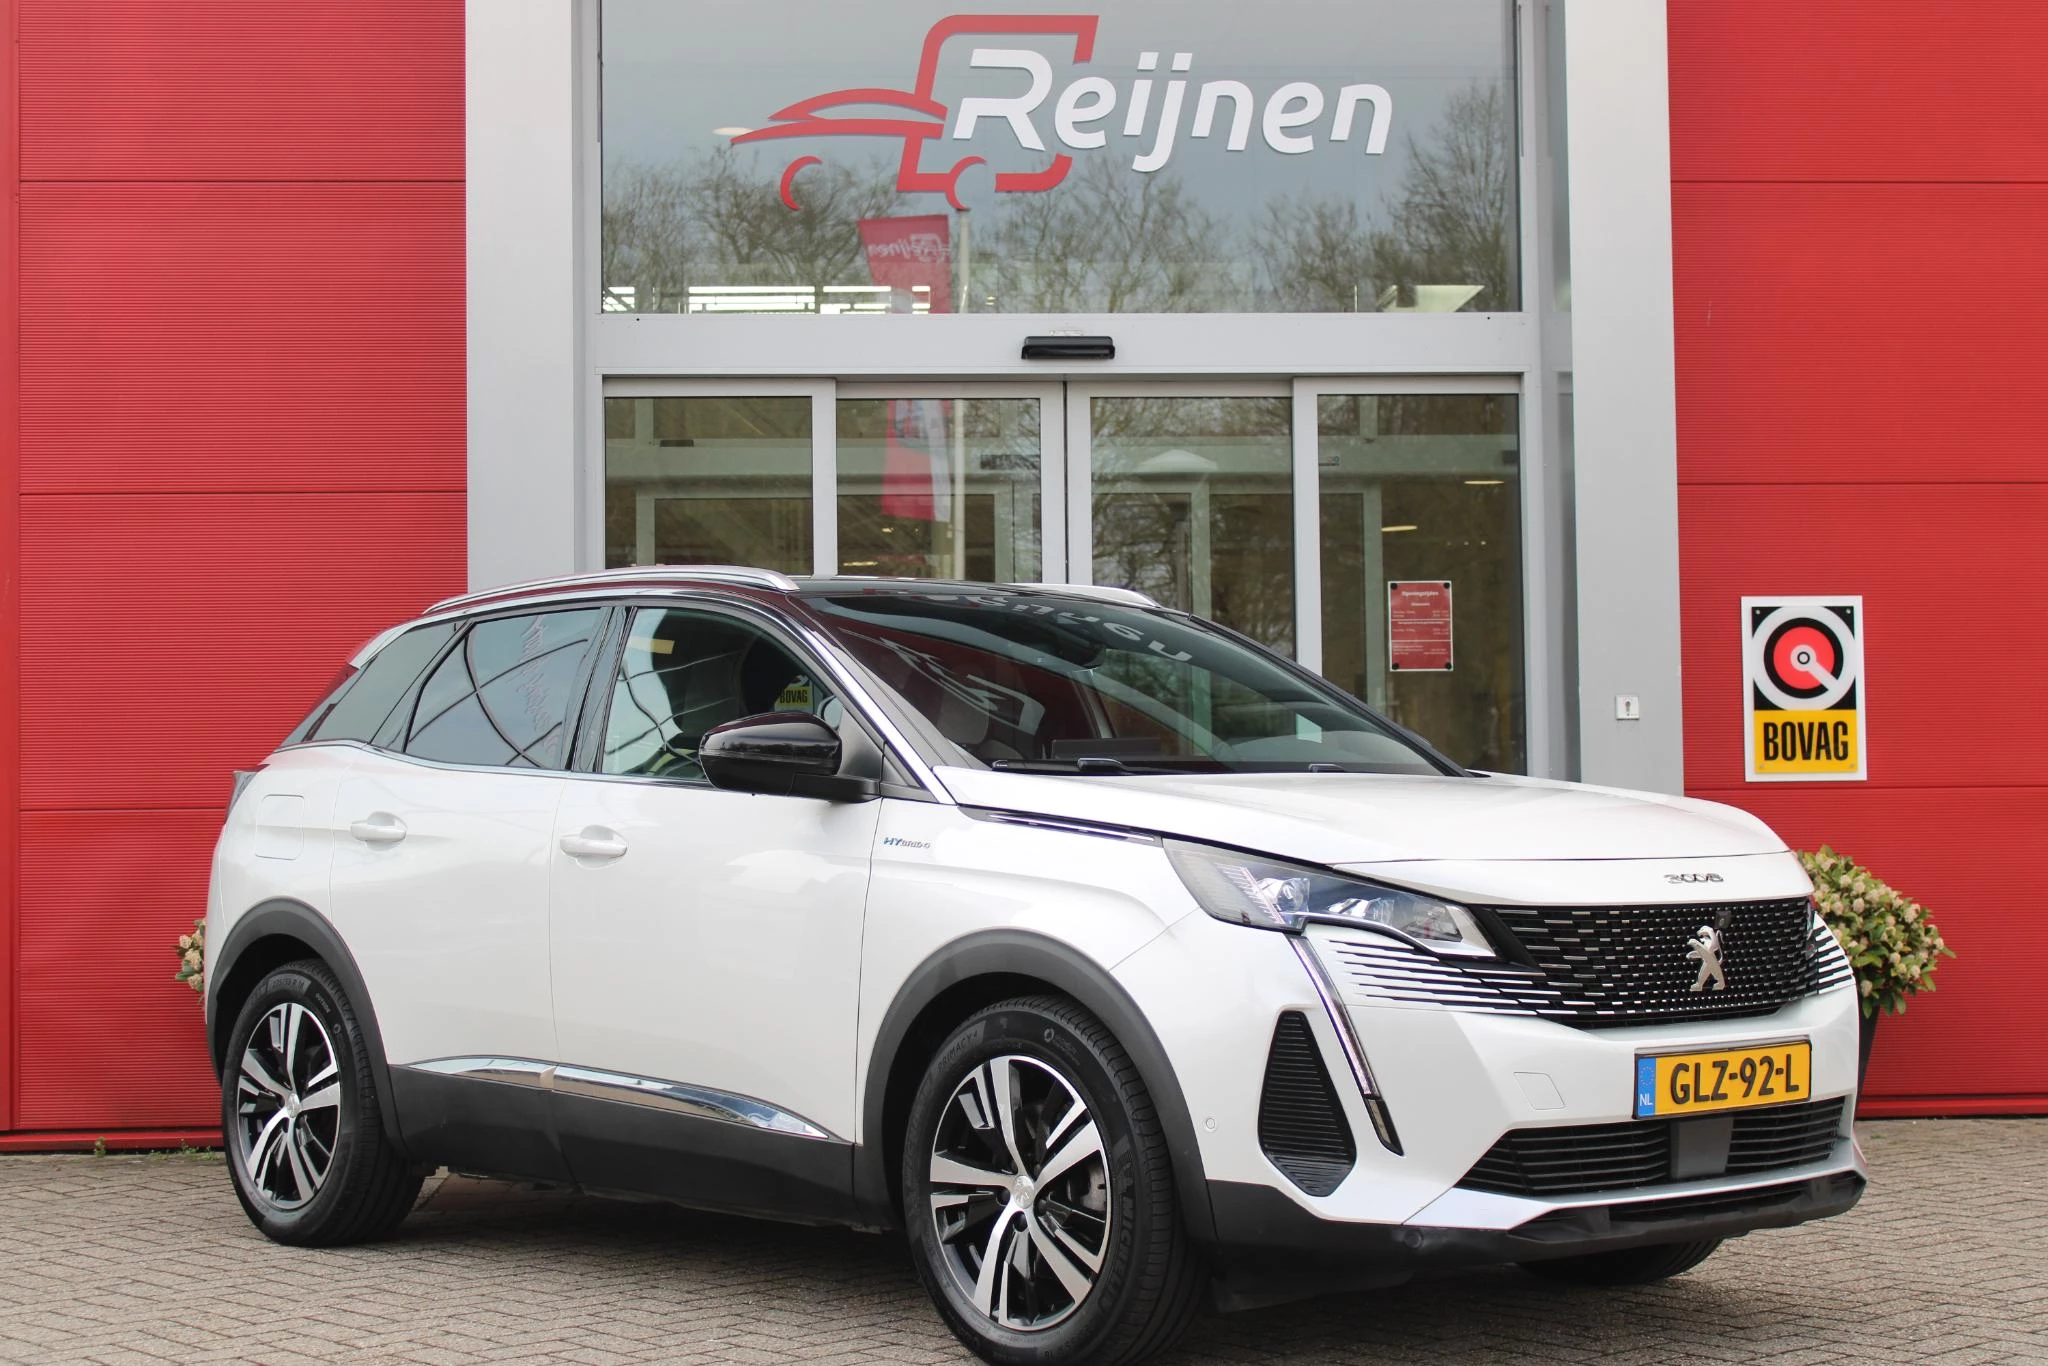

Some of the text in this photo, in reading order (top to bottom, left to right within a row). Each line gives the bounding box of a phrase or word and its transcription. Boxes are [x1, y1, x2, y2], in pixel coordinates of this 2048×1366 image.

[952, 48, 1393, 173] Reijnen
[1763, 720, 1849, 761] BOVAG
[1663, 872, 1724, 884] 3008
[937, 1033, 972, 1073] PRIMACY
[1670, 1053, 1800, 1105] GLZ-92-L
[1639, 1092, 1654, 1107] NL
